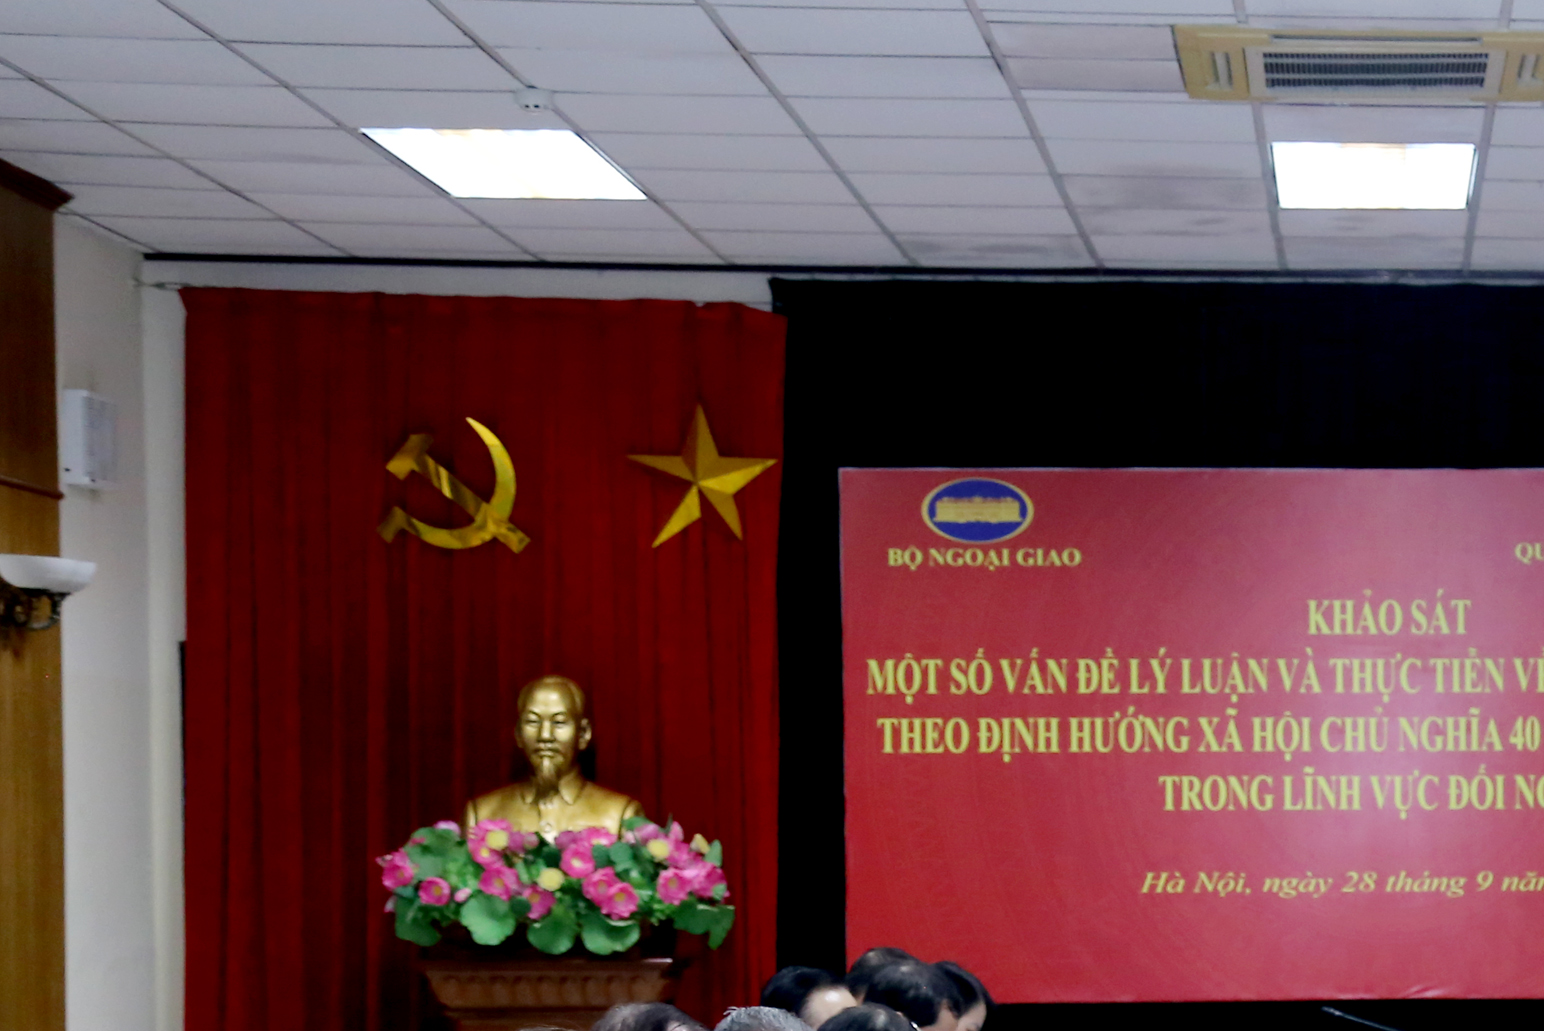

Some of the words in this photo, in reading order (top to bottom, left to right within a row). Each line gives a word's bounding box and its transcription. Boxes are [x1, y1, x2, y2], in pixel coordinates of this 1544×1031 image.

[887, 545, 924, 571] BỘ
[929, 548, 1011, 572] NGOẠI
[1015, 547, 1083, 567] GIAO
[1307, 589, 1403, 635] KHẢO
[1410, 589, 1472, 635] SÁT
[867, 652, 945, 704] MỘT
[949, 648, 994, 695] SỐ
[999, 647, 1069, 694] VẤN
[1076, 647, 1122, 695] ĐỀ
[1128, 647, 1173, 694] LÝ
[1181, 652, 1269, 703] LUẬN
[1276, 647, 1322, 693] VÀ
[1329, 652, 1422, 703] THỰC
[1430, 647, 1505, 693] TIỄN
[876, 717, 971, 754] THEO
[977, 717, 1061, 764] ĐỊNH
[1068, 705, 1190, 754] HƯỚNG
[1198, 707, 1244, 752] XÃ
[1252, 711, 1311, 762] HỘI
[1320, 706, 1388, 752] CHỦ
[1399, 707, 1503, 752] NGHĨA
[1509, 716, 1541, 751] 40
[1158, 774, 1275, 812] TRONG
[1283, 766, 1361, 811] LĨNH
[1370, 770, 1439, 820] VỰC
[1447, 765, 1506, 811] ĐỐI
[1141, 871, 1186, 894] Hà
[1193, 871, 1252, 897] Nội,
[1262, 872, 1334, 899] ngày
[1341, 870, 1378, 893] 28
[1385, 870, 1467, 898] tháng
[1476, 871, 1494, 891] 9
